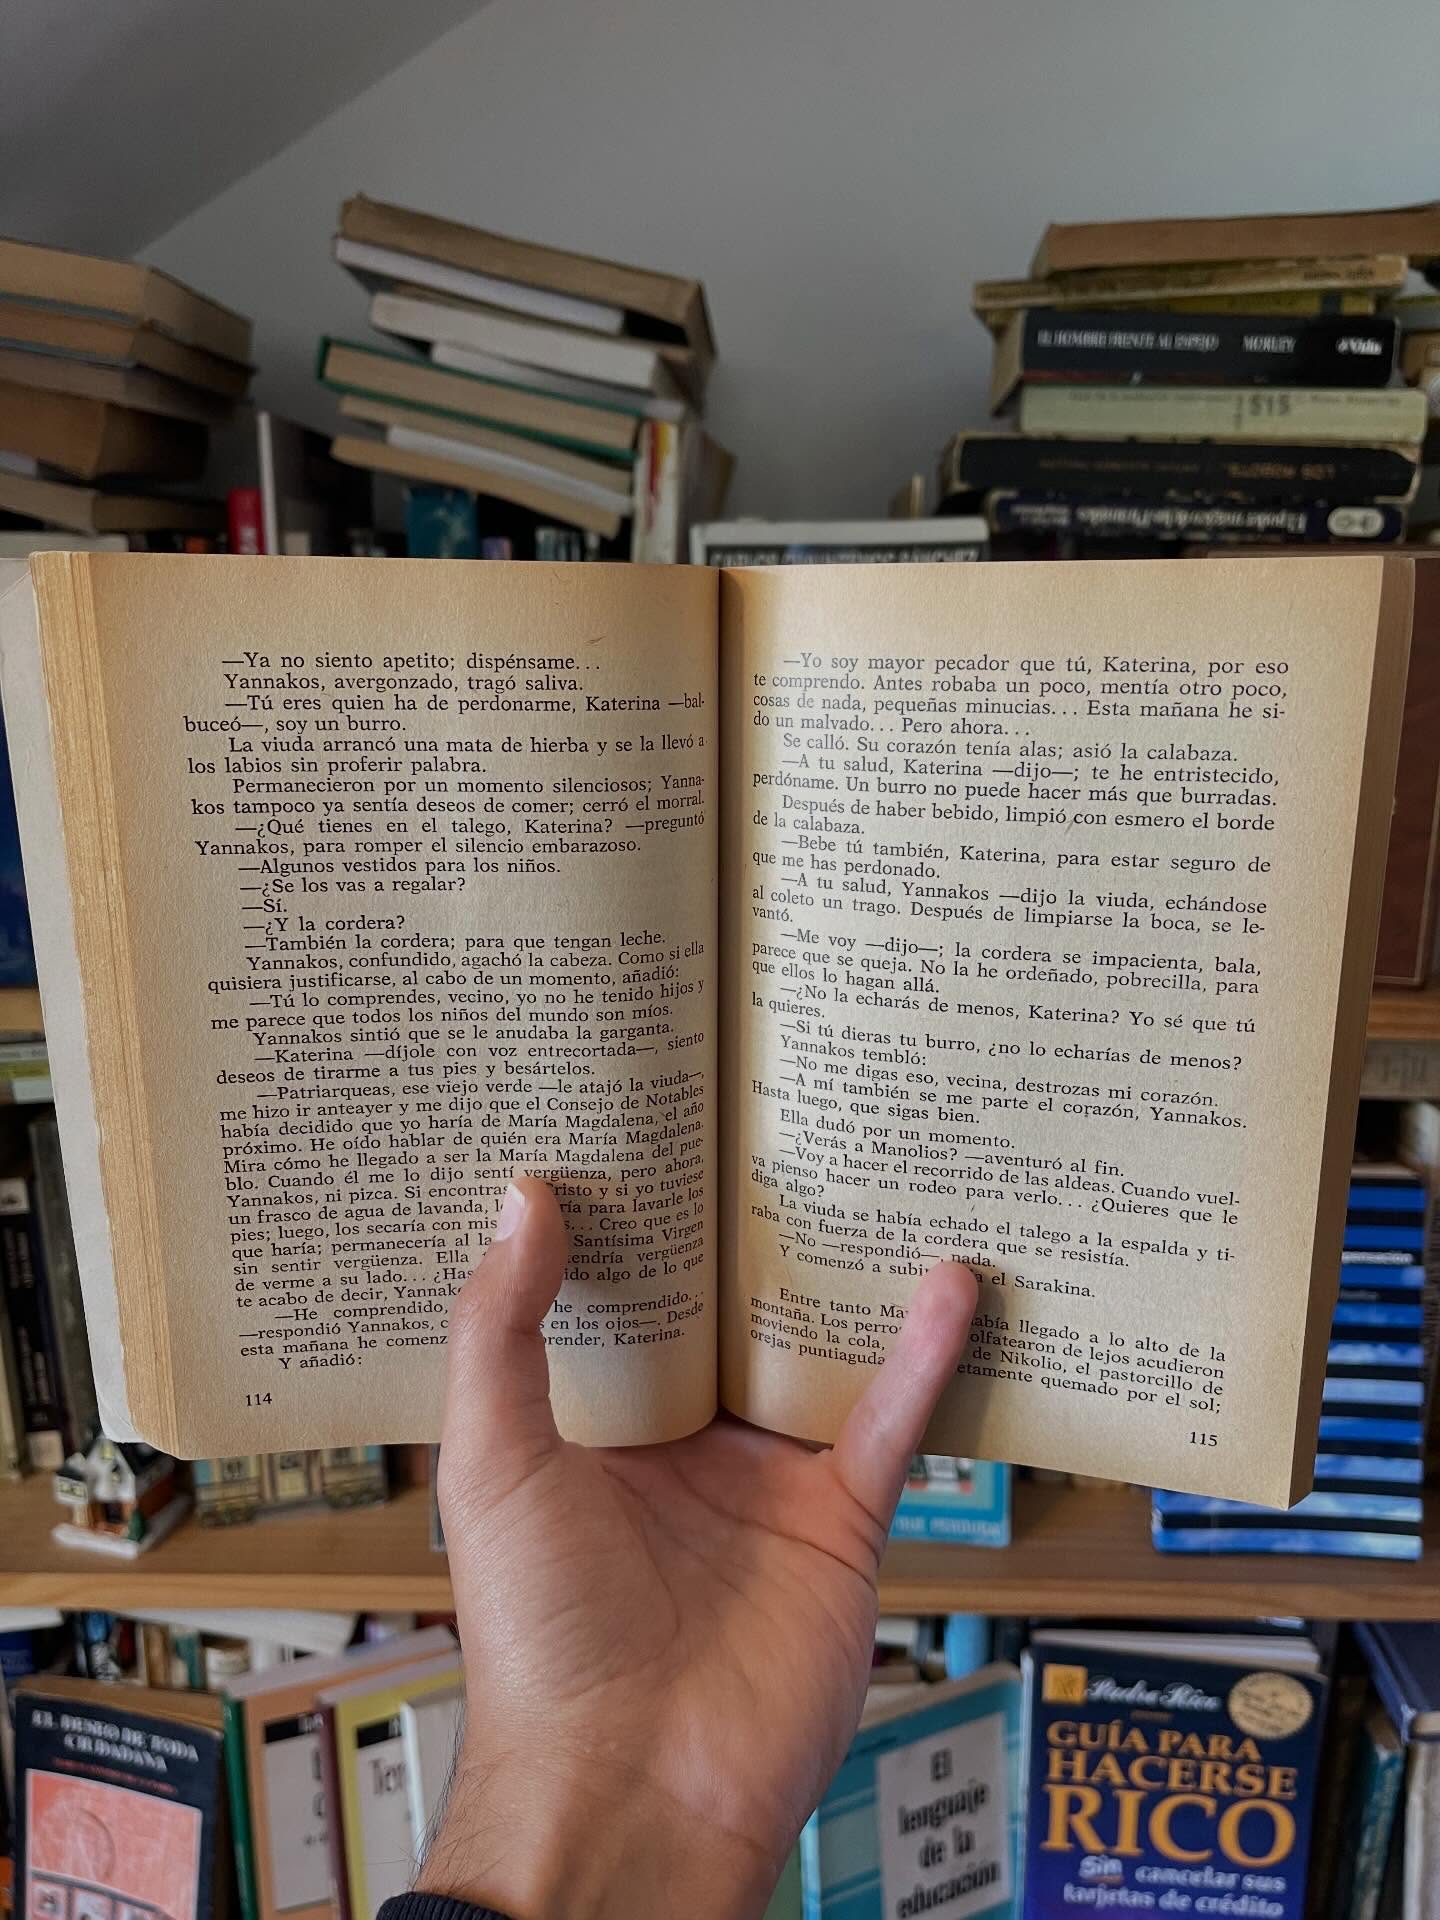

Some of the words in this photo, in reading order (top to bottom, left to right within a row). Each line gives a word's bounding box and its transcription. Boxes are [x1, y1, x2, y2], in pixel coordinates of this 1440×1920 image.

[280, 656, 305, 668] no
[315, 651, 373, 668] siento
[383, 652, 455, 672] apetito;
[831, 657, 858, 673] soy
[868, 658, 925, 674] mayor
[934, 654, 1010, 674] pecador
[1020, 660, 1055, 676] que
[1066, 656, 1092, 675] tú,
[1102, 656, 1196, 676] Katerina,
[1207, 661, 1245, 678] por
[1255, 662, 1289, 674] eso
[223, 672, 325, 692] Yannakos,
[334, 673, 458, 693] avergonzado,
[467, 674, 516, 694] tragó
[525, 671, 583, 691] saliva.
[282, 698, 322, 710] eres
[331, 697, 385, 714] quien
[393, 693, 418, 711] ha
[427, 694, 449, 711] de
[457, 694, 576, 715] perdonarme,
[585, 695, 661, 712] Katerina
[276, 719, 308, 735] soy
[314, 720, 341, 731] un
[345, 714, 406, 731] burro.
[783, 733, 801, 747] Se
[807, 734, 849, 750] calló.
[857, 736, 879, 752] Su
[887, 739, 956, 755] corazón
[965, 740, 1011, 756] tenía
[1019, 740, 1062, 760] alas;
[1073, 743, 1112, 759] asió
[1120, 742, 1138, 759] la
[1147, 743, 1237, 762] calabaza.
[194, 838, 294, 857] Yannakos,
[302, 842, 346, 857] para
[354, 841, 423, 856] romper
[431, 836, 447, 853] el
[455, 837, 524, 854] silencio
[532, 837, 641, 854] embarazoso.
[341, 856, 417, 873] vestidos
[424, 861, 466, 876] para
[473, 857, 499, 873] los
[507, 858, 561, 873] niños.
[301, 876, 328, 893] los
[335, 881, 366, 892] vas
[374, 880, 385, 892] a
[392, 876, 465, 895] regalar?
[298, 915, 316, 932] la
[325, 914, 405, 931] cordera?
[354, 933, 372, 949] la
[380, 932, 455, 950] cordera;
[465, 937, 505, 952] para
[513, 938, 545, 952] que
[553, 936, 611, 952] tengan
[620, 929, 665, 947] leche.
[834, 987, 848, 1003] la
[856, 991, 920, 1010] echarás
[928, 997, 949, 1013] de
[956, 1003, 1019, 1020] menos,
[1028, 1004, 1120, 1024] Katerina?
[1129, 1011, 1154, 1027] Yo
[1164, 1014, 1183, 1028] sé
[1192, 1019, 1227, 1034] que
[1236, 1018, 1255, 1033] tú
[252, 1028, 342, 1046] Yannakos
[350, 1027, 400, 1043] sintió
[408, 1029, 440, 1044] que
[448, 1029, 465, 1040] se
[472, 1024, 488, 1039] le
[495, 1024, 569, 1040] anudaba
[576, 1025, 592, 1040] la
[599, 1022, 674, 1043] garganta.
[818, 1024, 834, 1038] tú
[841, 1025, 891, 1044] dieras
[899, 1033, 917, 1047] tu
[925, 1033, 980, 1054] burro,
[988, 1043, 1021, 1058] ¿no
[1029, 1041, 1046, 1057] lo
[1054, 1043, 1130, 1063] echarías
[1139, 1049, 1161, 1065] de
[1170, 1056, 1242, 1070] menos?
[780, 1108, 808, 1126] Ella
[816, 1115, 855, 1134] dudó
[863, 1126, 892, 1139] por
[898, 1129, 920, 1141] un
[928, 1132, 1015, 1149] momento.
[854, 1142, 863, 1153] a
[871, 1140, 958, 1161] Manolios?
[1070, 1158, 1087, 1173] al
[1094, 1159, 1124, 1177] fin.
[779, 1244, 790, 1257] Y
[797, 1252, 864, 1271] comenzó
[872, 1263, 881, 1273] a
[991, 1273, 1006, 1287] el
[1014, 1275, 1096, 1298] Sarakina.
[278, 1357, 292, 1370] Y
[299, 1353, 362, 1369] añadió:
[245, 1392, 273, 1407] 114
[1190, 1431, 1218, 1447] 115
[1047, 1720, 1150, 1751] GUÍA
[1159, 1730, 1262, 1762] PARA
[931, 1748, 952, 1781] El
[1048, 1748, 1299, 1799] HACERSE
[899, 1778, 989, 1835] lenguaje
[1040, 1783, 1297, 1868] RICO
[919, 1836, 946, 1867] de
[954, 1826, 975, 1855] la
[1079, 1856, 1124, 1880] Sin
[1135, 1866, 1240, 1889] cancelar
[1243, 1874, 1286, 1893] sus
[1064, 1882, 1155, 1907] tarjetas
[1159, 1889, 1192, 1911] de
[1195, 1894, 1284, 1918] crédito
